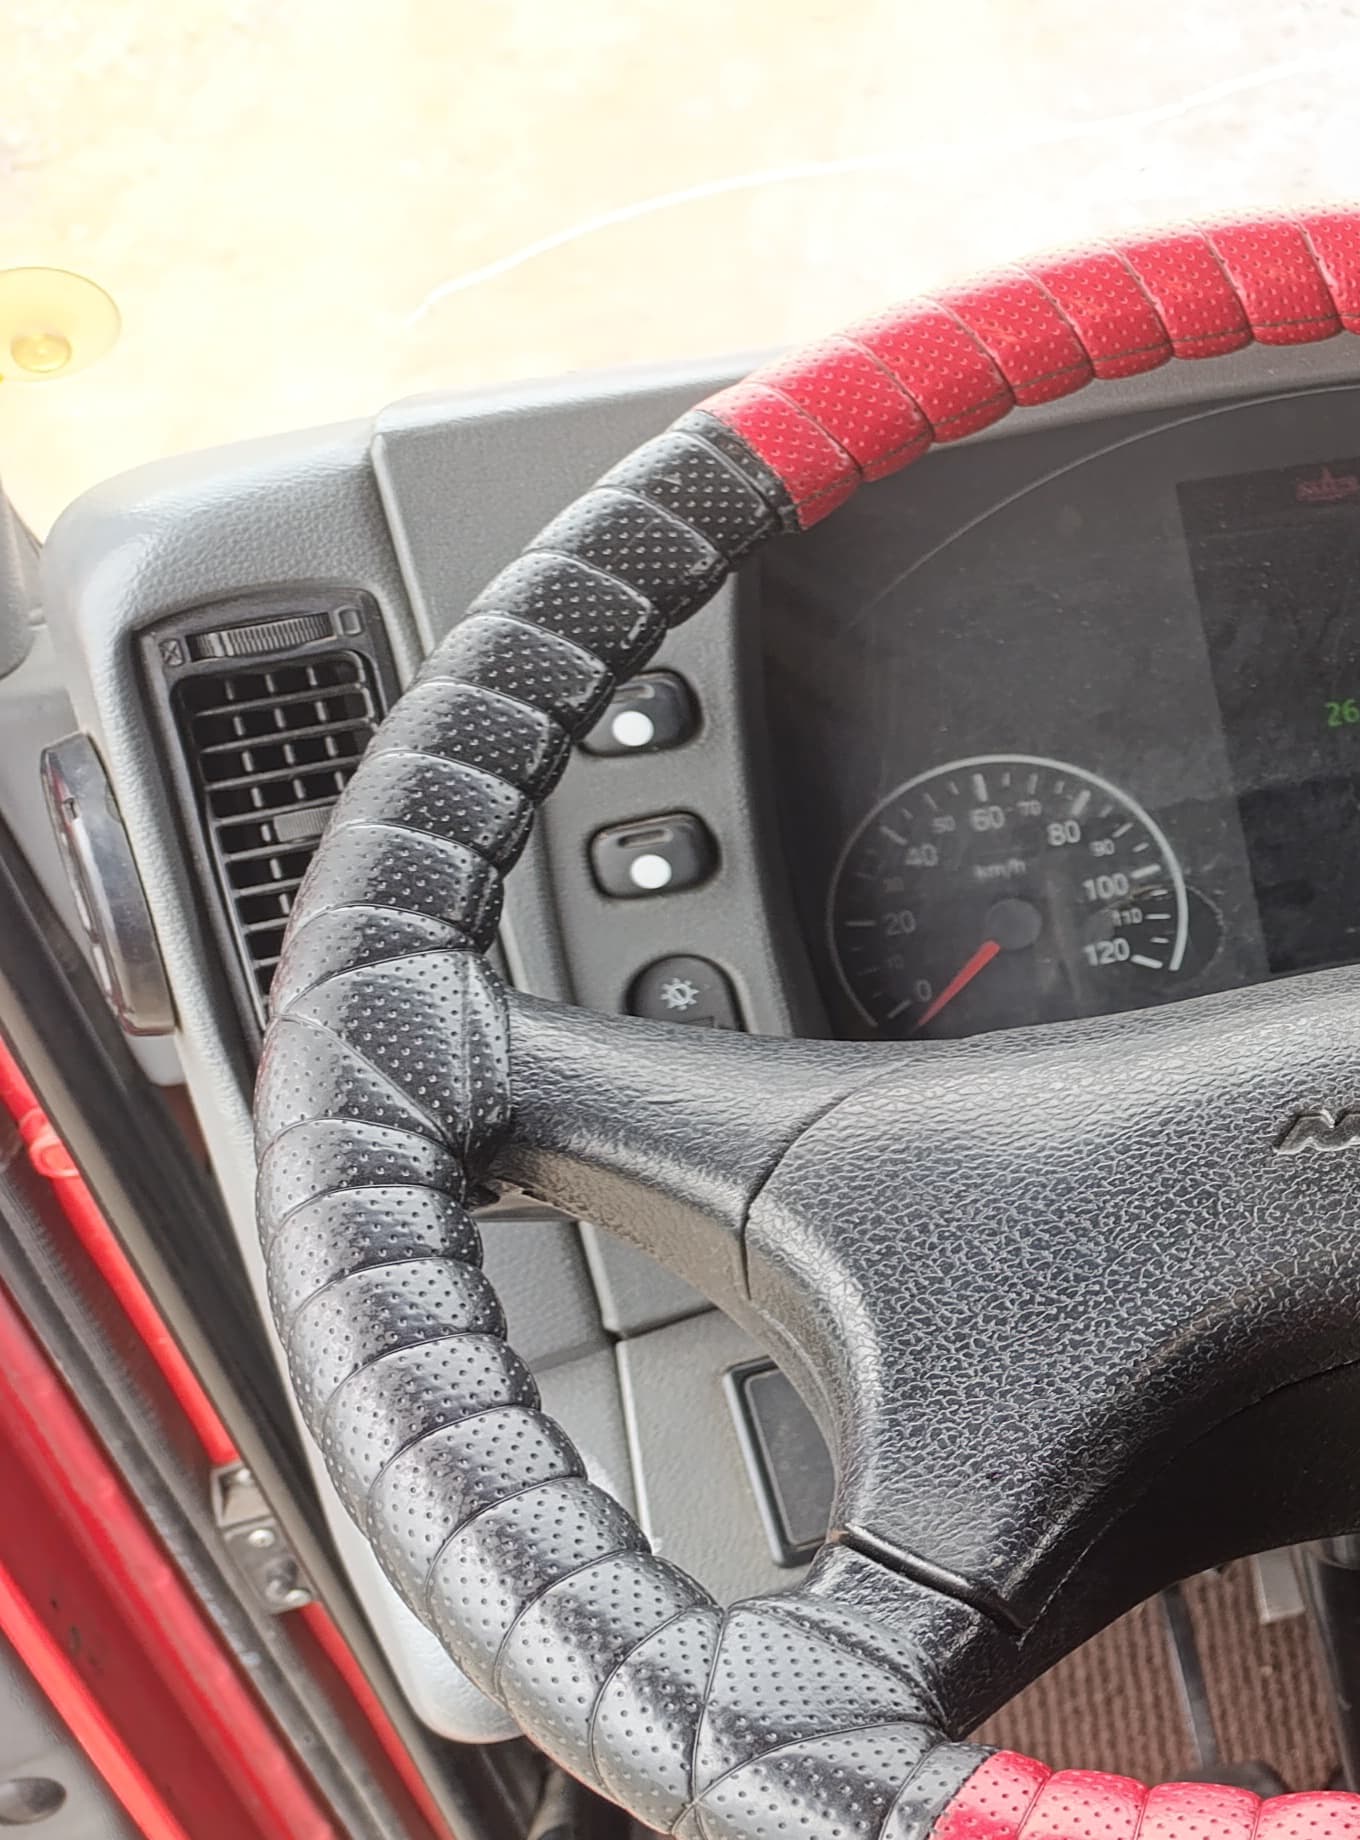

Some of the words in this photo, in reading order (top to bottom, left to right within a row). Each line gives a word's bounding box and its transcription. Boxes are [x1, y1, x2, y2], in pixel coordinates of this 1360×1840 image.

[932, 815, 956, 834] 50
[970, 805, 1005, 831] 60
[1047, 820, 1080, 846] 80
[905, 843, 938, 867] 40
[1090, 839, 1115, 857] 90
[1083, 875, 1130, 900] 100
[882, 910, 917, 936] 20
[1084, 938, 1130, 966] 120
[917, 979, 933, 1001] 0
